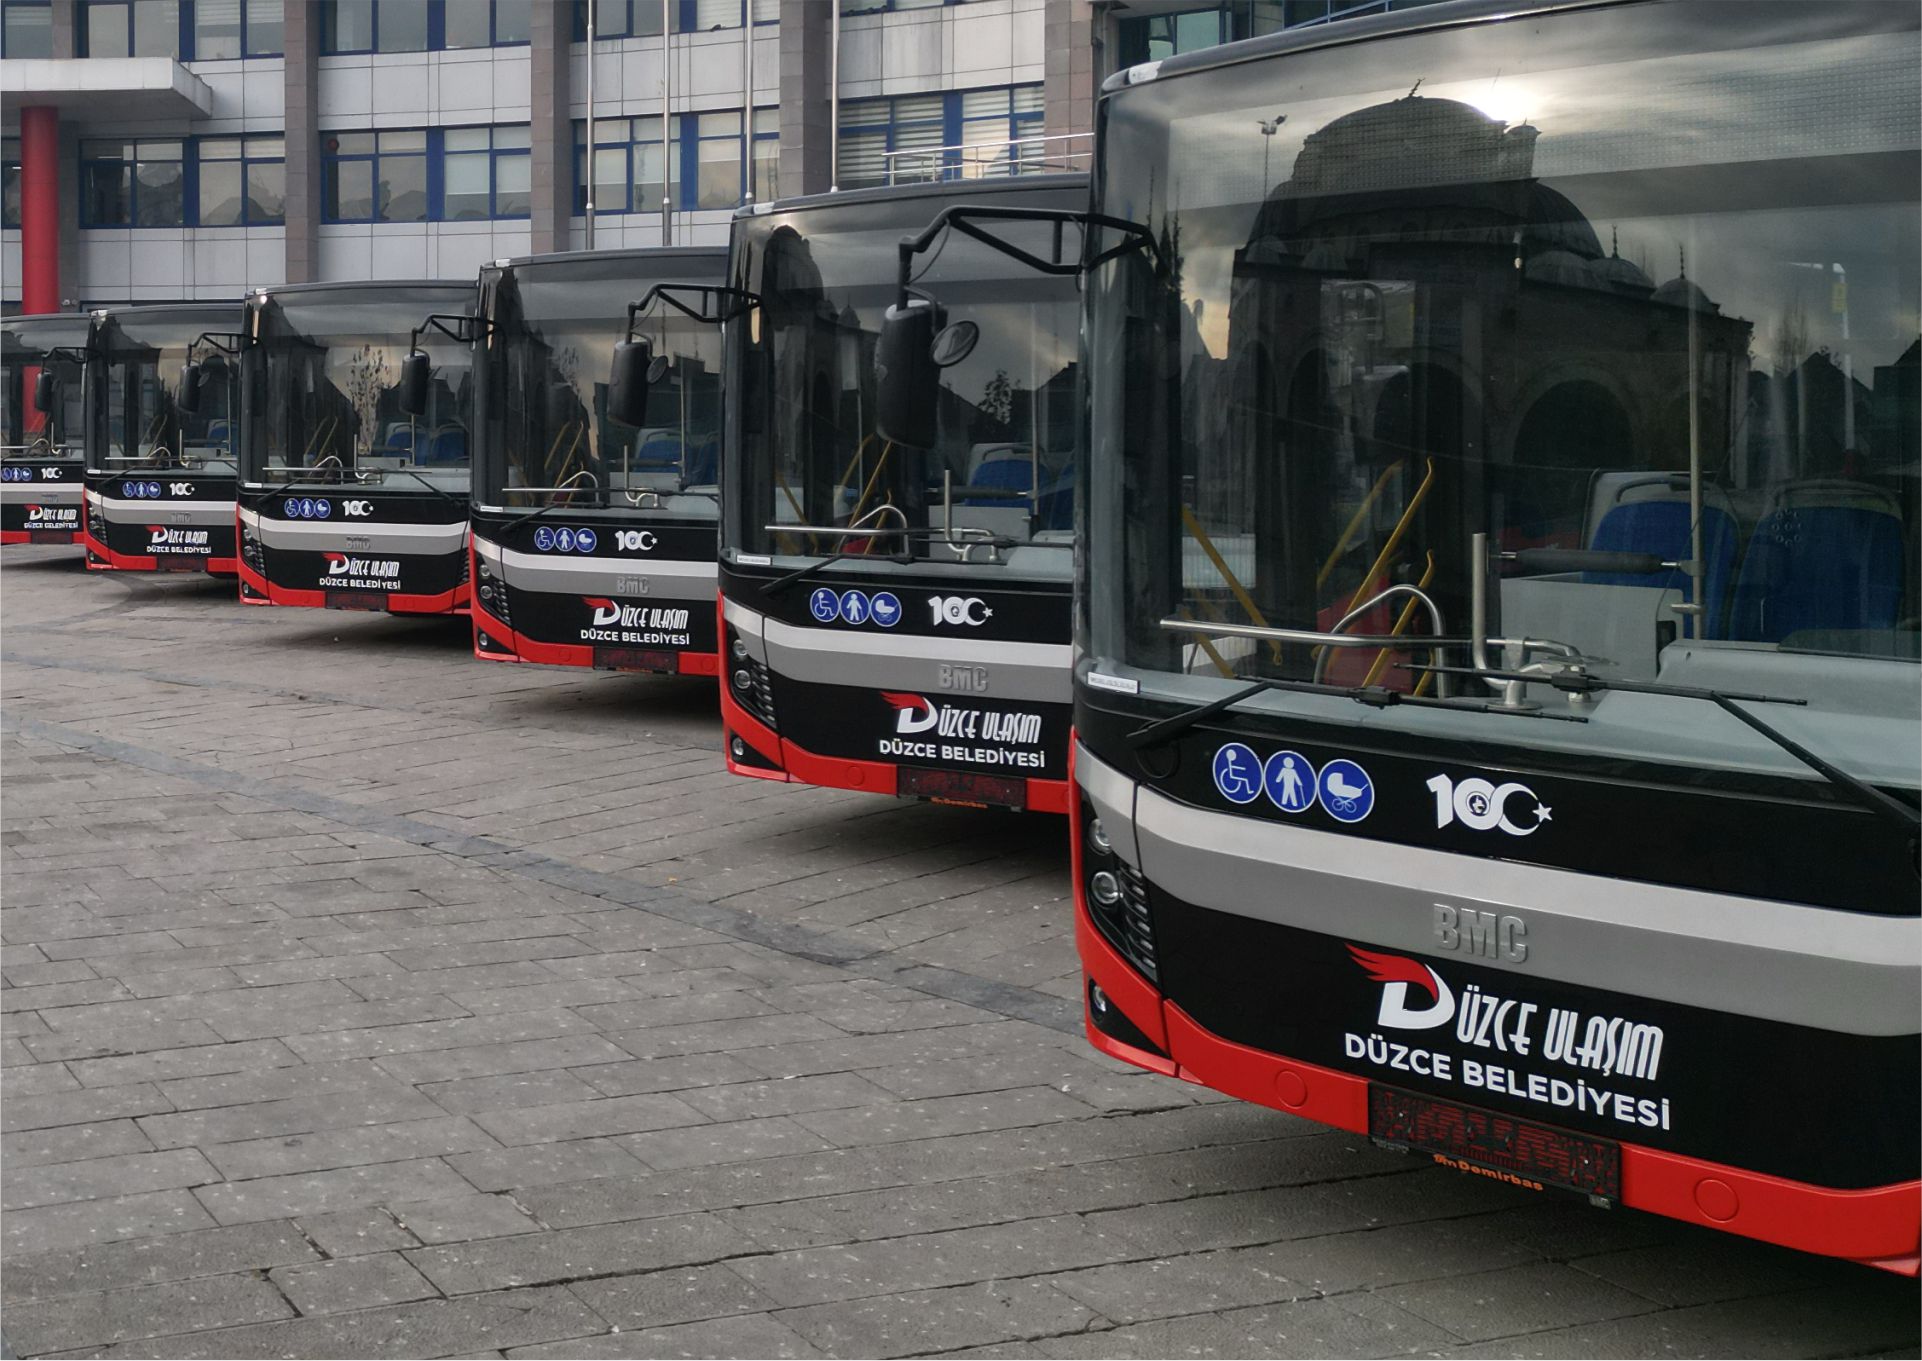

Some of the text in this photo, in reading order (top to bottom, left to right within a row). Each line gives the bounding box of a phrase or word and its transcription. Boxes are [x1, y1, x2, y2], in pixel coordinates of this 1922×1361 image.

[319, 577, 401, 590] DÜZCE BELEDİYESİ
[582, 596, 649, 627] DÜZCE
[580, 628, 690, 645] DÜZCE BELEDİYESİ
[938, 664, 989, 692] BMC
[880, 691, 1042, 745] DÜZCE ULAŞIM
[879, 738, 1045, 768] DÜZCE BELEDİYESİ
[1433, 903, 1528, 963] BMC
[1344, 943, 1664, 1081] DÜZCE ULAŞIM
[1343, 1033, 1671, 1131] DÜZCE BELEDİYESİ
